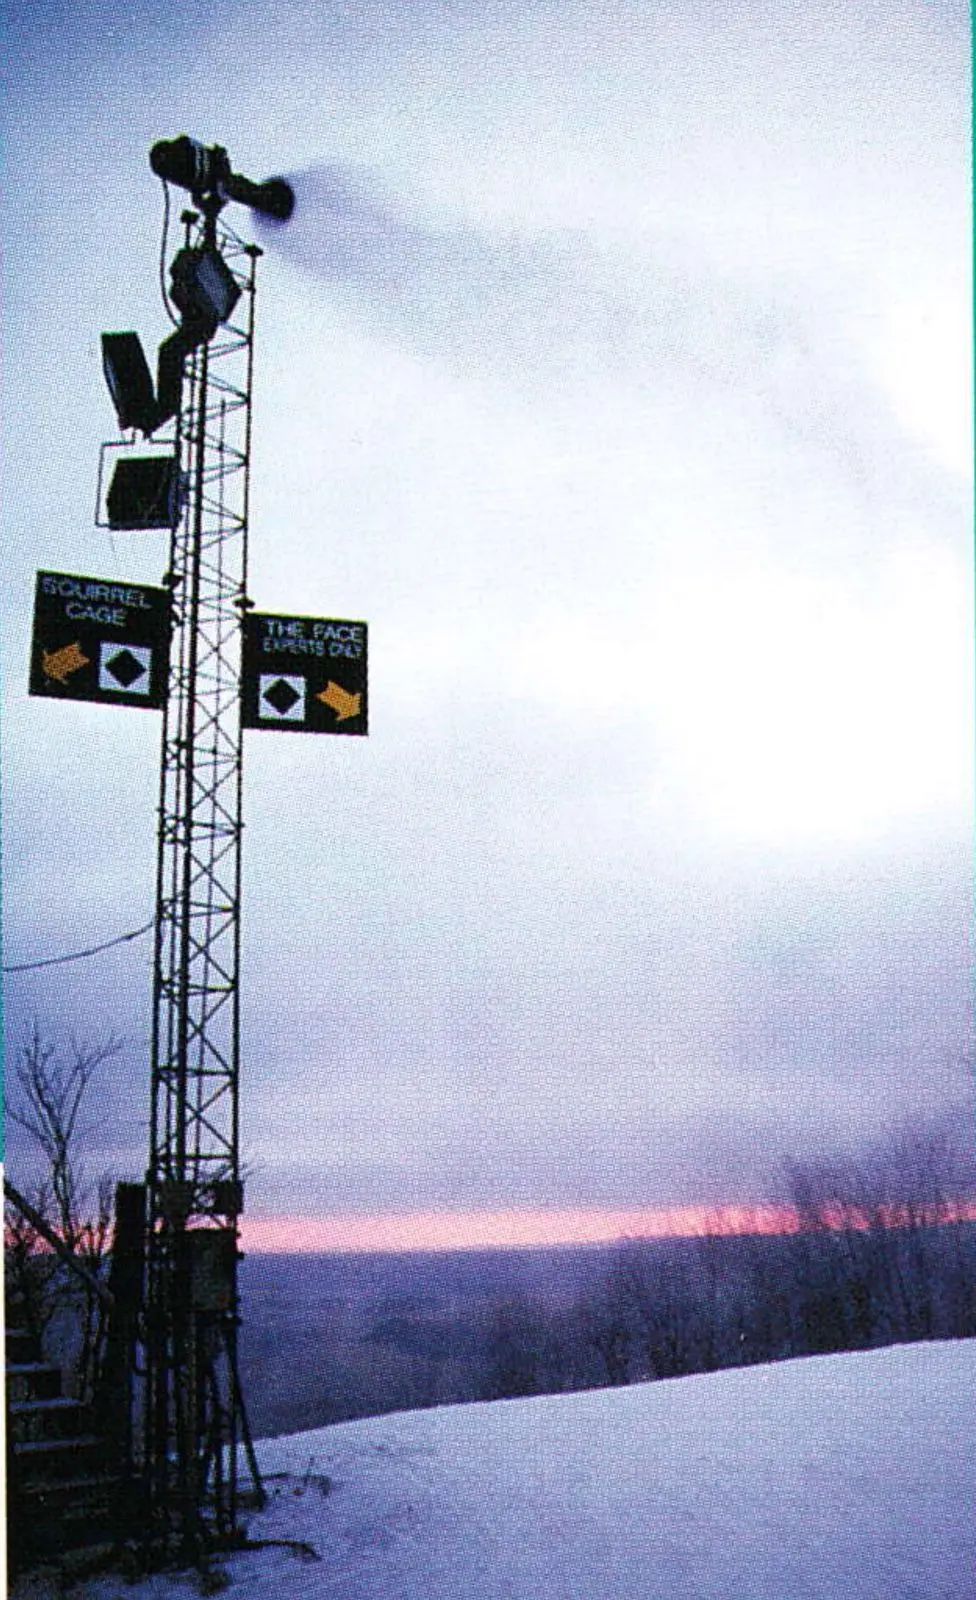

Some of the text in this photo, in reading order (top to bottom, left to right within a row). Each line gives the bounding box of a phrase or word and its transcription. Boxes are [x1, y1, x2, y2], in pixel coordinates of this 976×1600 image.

[42, 577, 152, 609] SQUIRREL
[65, 602, 126, 627] CAGE
[265, 619, 303, 639] THE
[263, 637, 324, 657] EXPERTS
